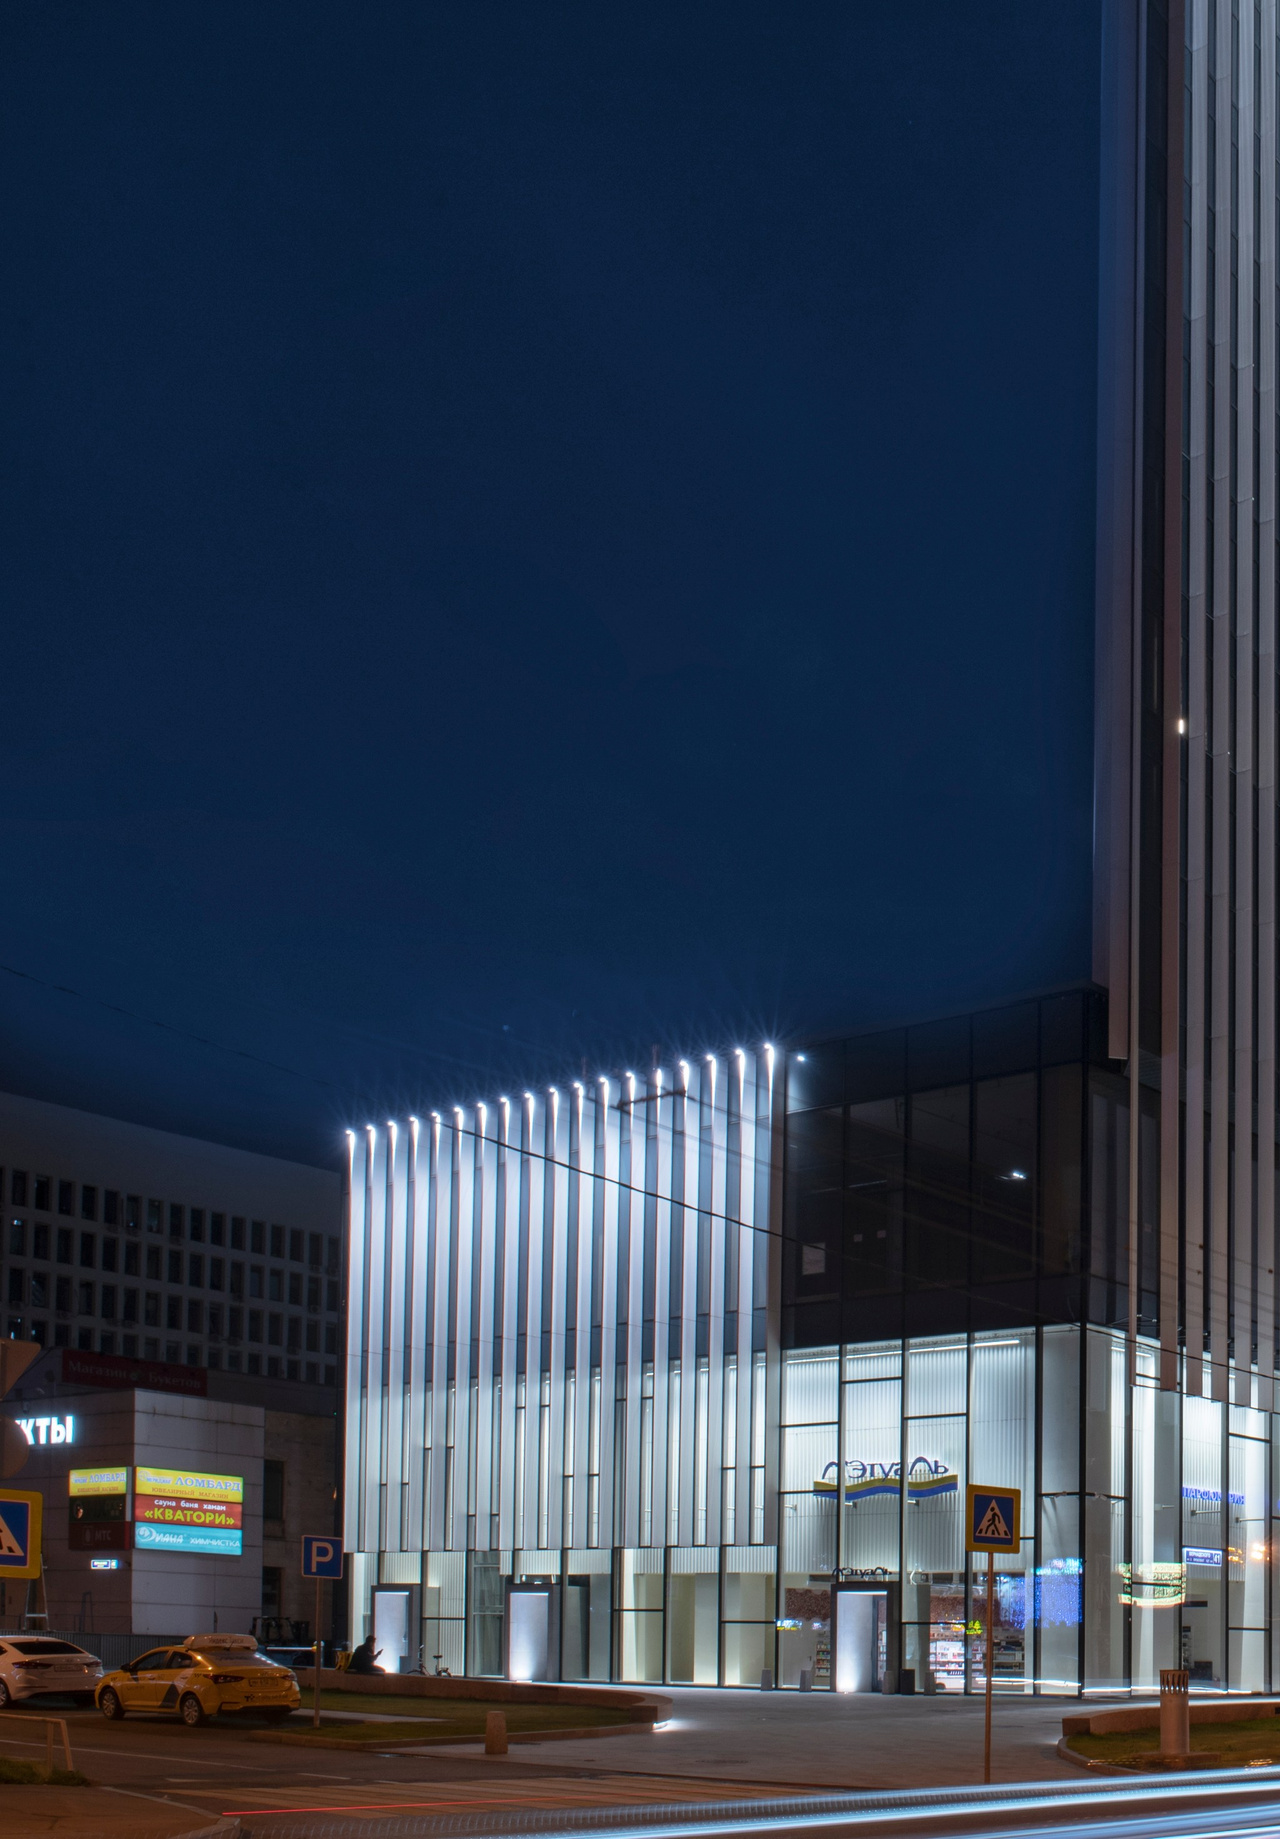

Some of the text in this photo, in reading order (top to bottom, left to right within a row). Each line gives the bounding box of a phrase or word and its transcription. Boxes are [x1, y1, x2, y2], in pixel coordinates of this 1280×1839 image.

[14, 1415, 74, 1445] КТЫ
[88, 1472, 126, 1483] ЛОМБАРД
[175, 1477, 242, 1492] ЛОМБАРД
[198, 1491, 229, 1499] МАГАЗИН
[154, 1499, 226, 1511] сауна баня хамам
[190, 1537, 240, 1547] ХИМЧИСТКА
